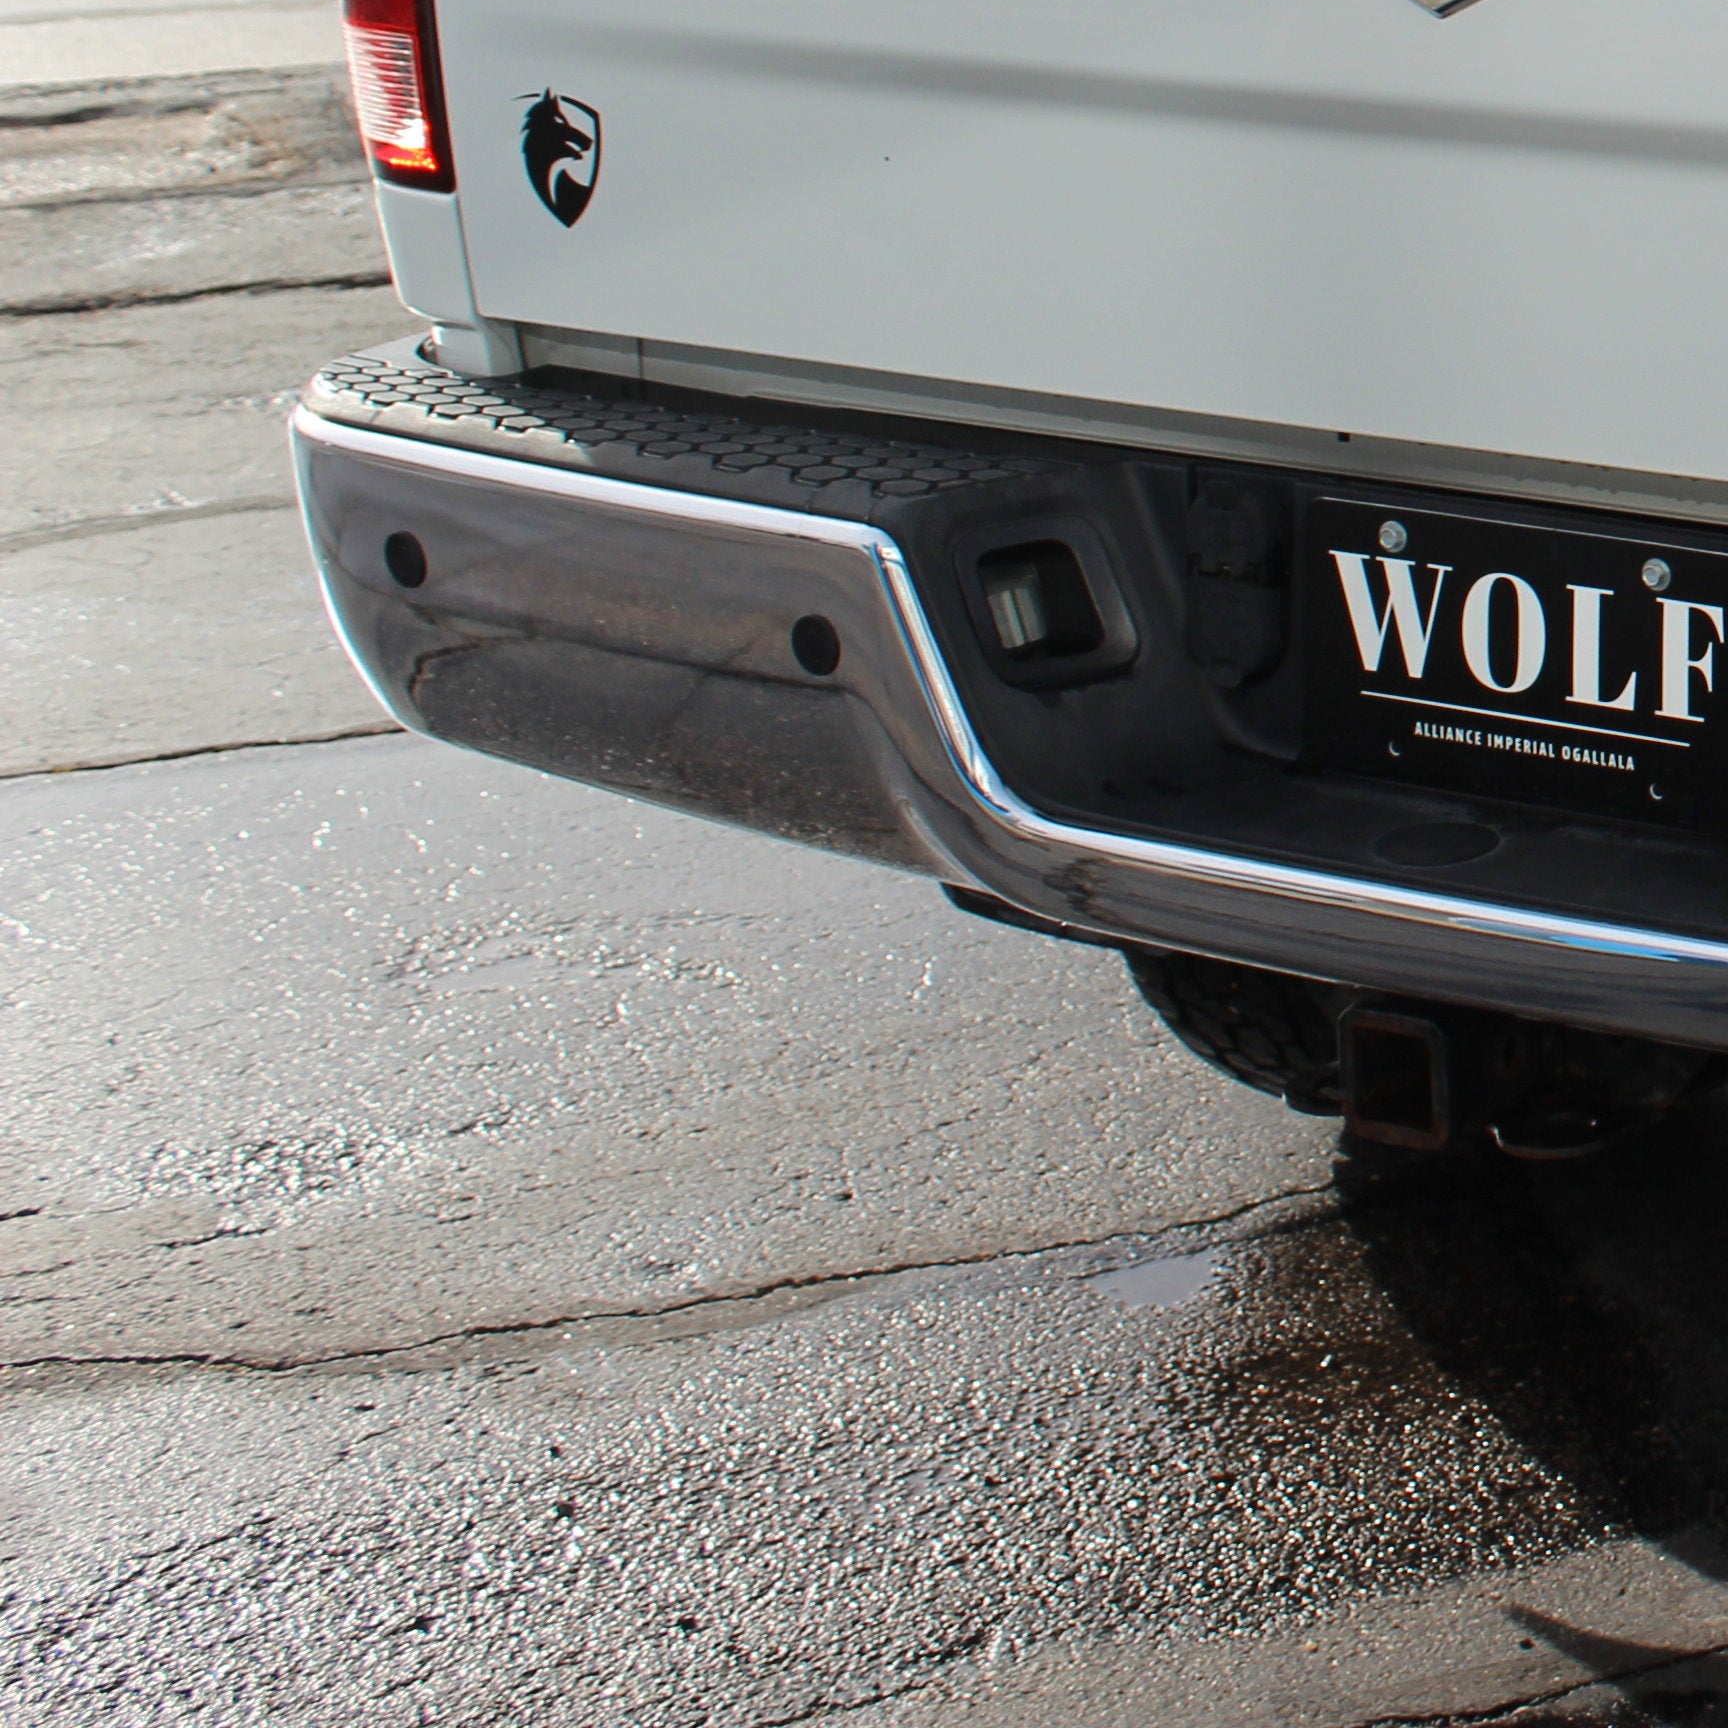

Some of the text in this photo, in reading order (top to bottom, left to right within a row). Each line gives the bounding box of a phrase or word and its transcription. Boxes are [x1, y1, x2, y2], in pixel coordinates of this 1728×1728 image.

[1328, 549, 1726, 723] WOLF
[1413, 720, 1636, 772] ALLIANCE IMPERIAL OGALLALA
